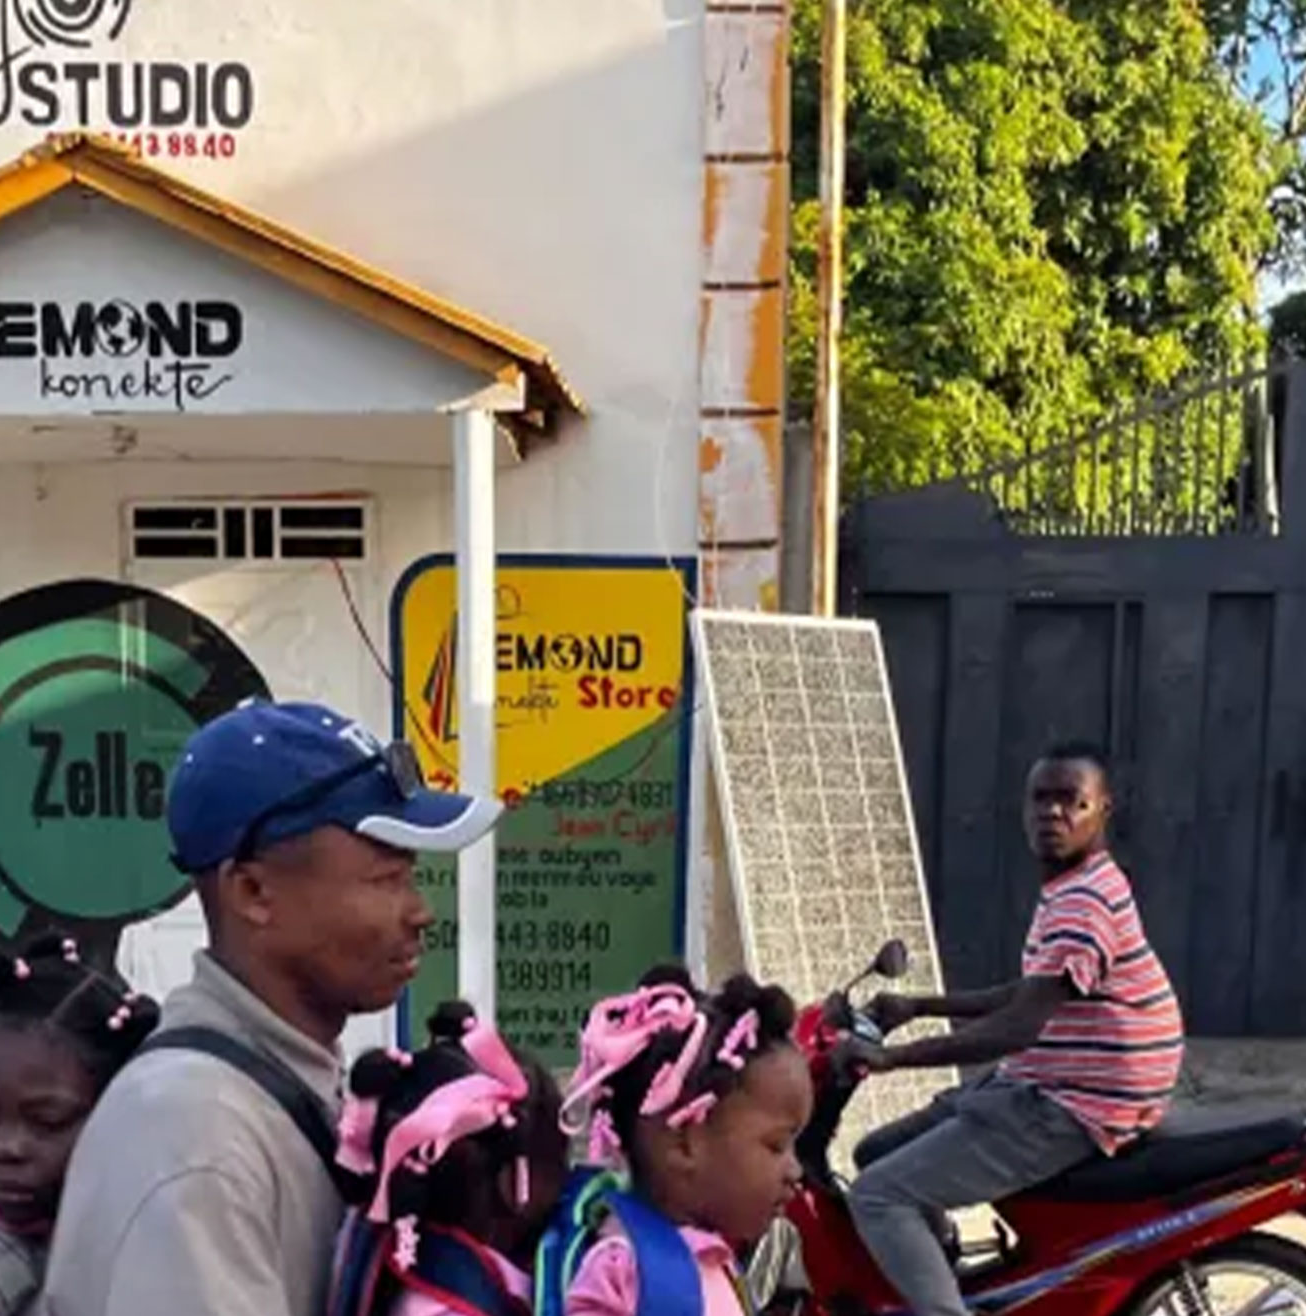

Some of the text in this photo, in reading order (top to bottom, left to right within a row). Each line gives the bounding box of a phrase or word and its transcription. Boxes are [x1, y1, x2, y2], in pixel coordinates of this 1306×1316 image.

[16, 62, 253, 128] STUDIO
[40, 358, 233, 412] konekte
[496, 633, 643, 672] EMOND
[577, 674, 678, 708] Store
[28, 723, 164, 825] Zelle
